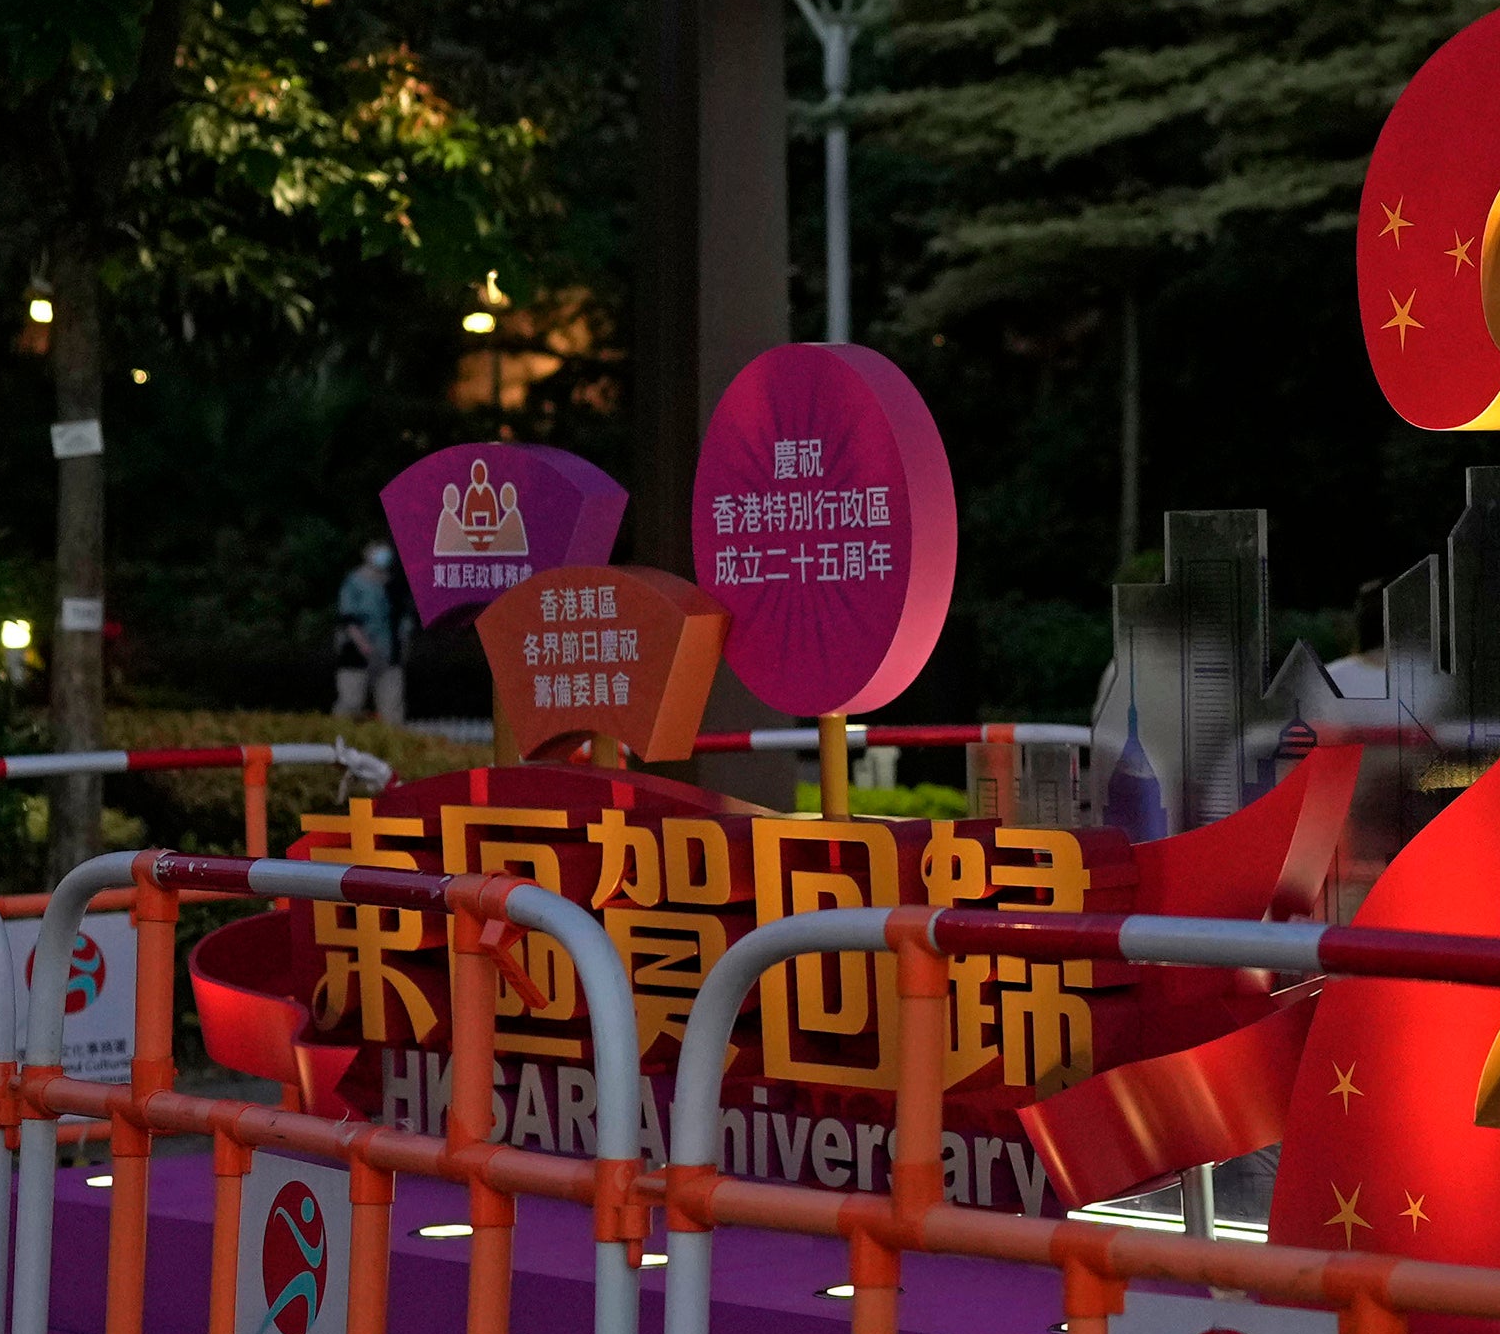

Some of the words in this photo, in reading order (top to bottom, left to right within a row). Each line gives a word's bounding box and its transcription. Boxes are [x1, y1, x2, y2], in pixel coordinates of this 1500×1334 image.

[773, 438, 824, 480] 慶祝
[712, 486, 892, 535] 香港特別行政區
[714, 540, 893, 586] 成立二十五周年
[540, 585, 618, 622] 香港東區
[523, 629, 639, 666] 各界節日慶祝
[533, 671, 630, 708] 籌備委員會
